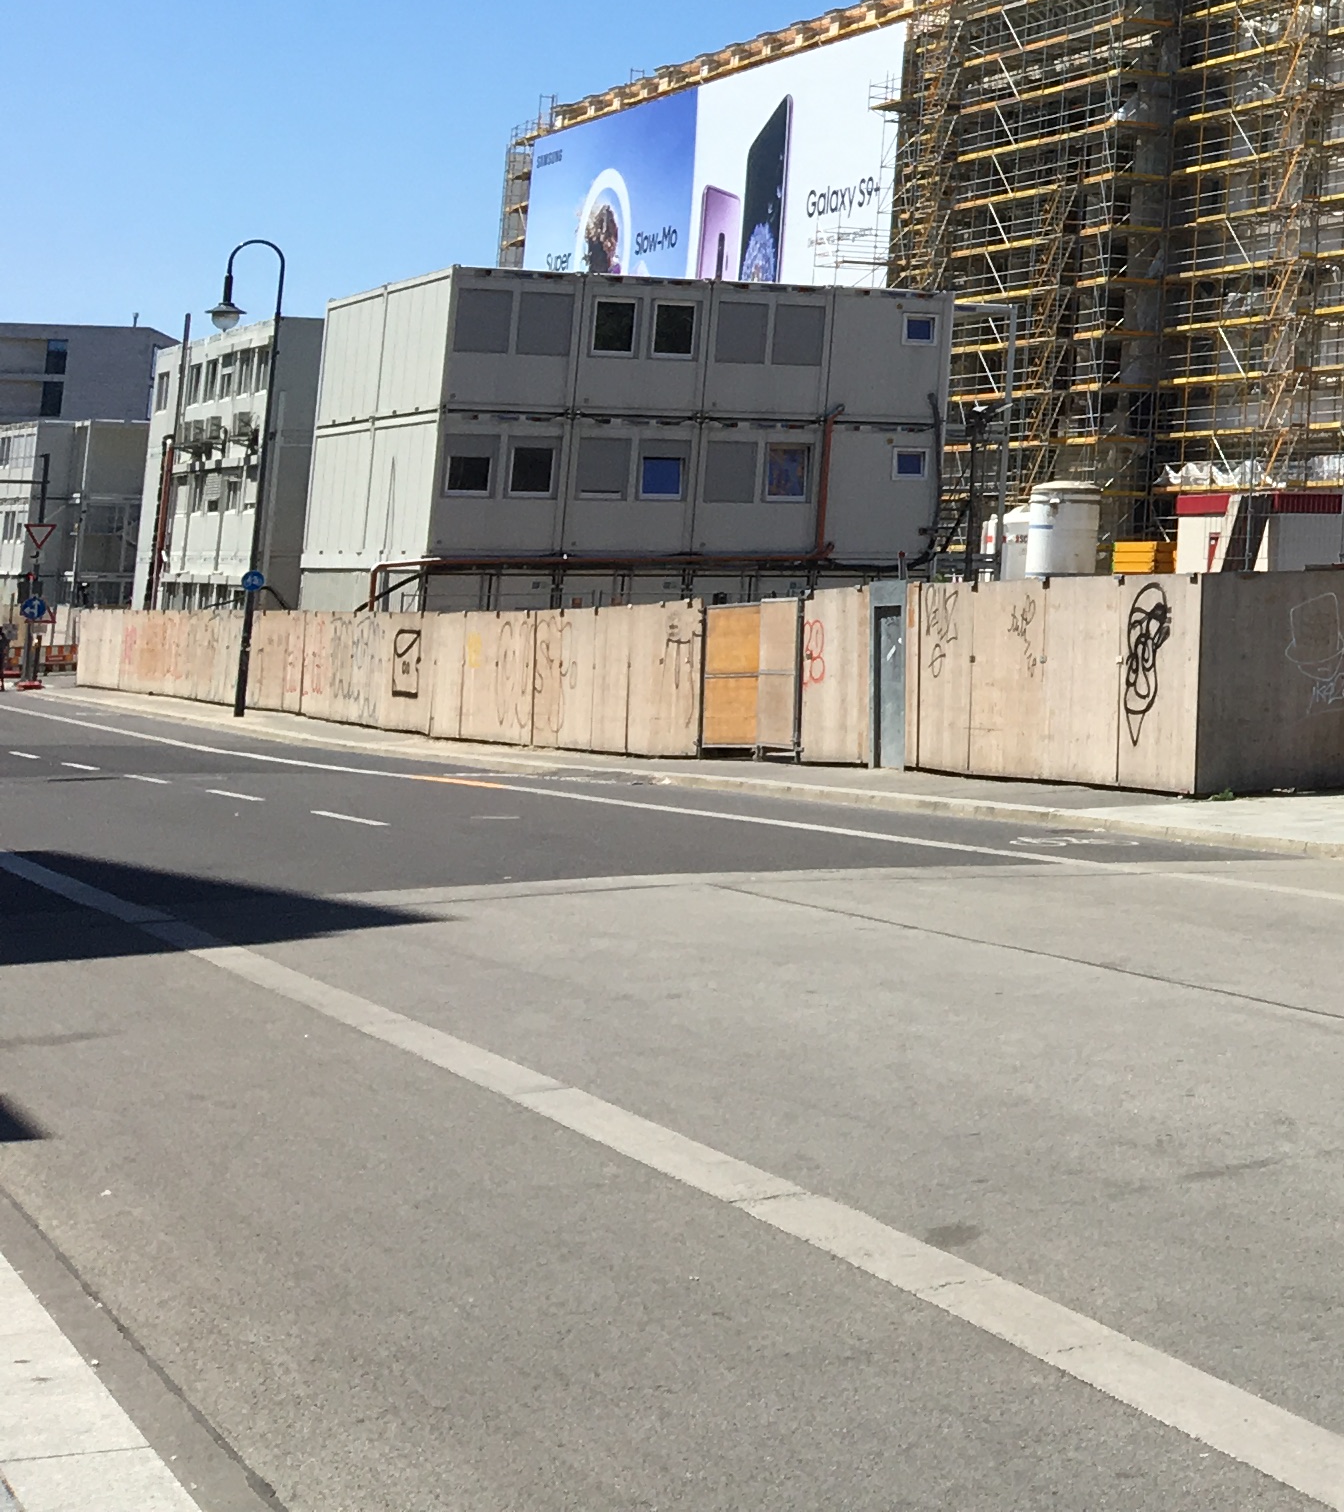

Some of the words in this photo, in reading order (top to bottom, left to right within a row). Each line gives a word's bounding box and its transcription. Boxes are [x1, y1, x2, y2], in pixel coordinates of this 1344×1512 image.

[536, 148, 563, 169] SAMSUNG
[806, 185, 856, 219] Galaxy
[857, 176, 880, 208] S9+
[634, 225, 678, 256] Slow-Mo
[546, 252, 572, 271] Super
